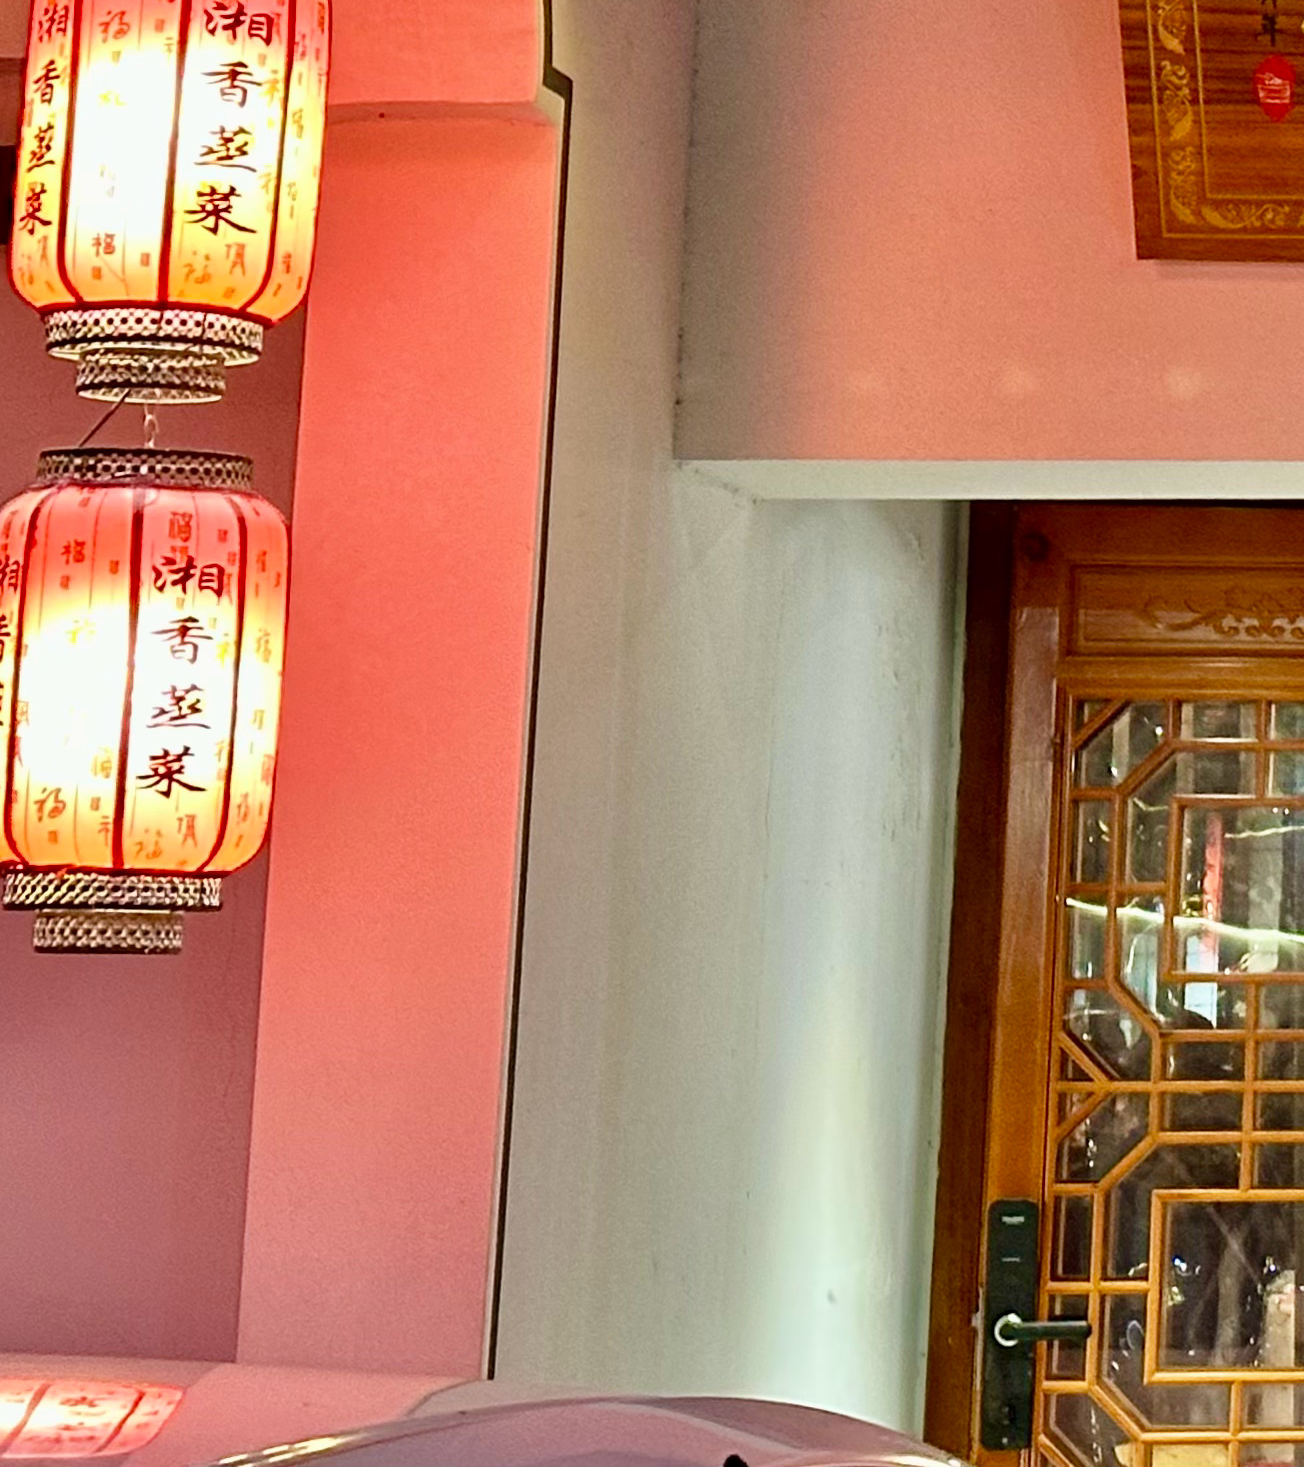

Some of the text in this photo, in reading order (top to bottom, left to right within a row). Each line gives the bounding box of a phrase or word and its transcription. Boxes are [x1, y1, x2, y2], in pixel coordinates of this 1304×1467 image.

[19, 4, 69, 235] 湘香蒸菜
[184, 1, 274, 236] 湘香蒸菜
[135, 554, 225, 799] 湘香蒸菜
